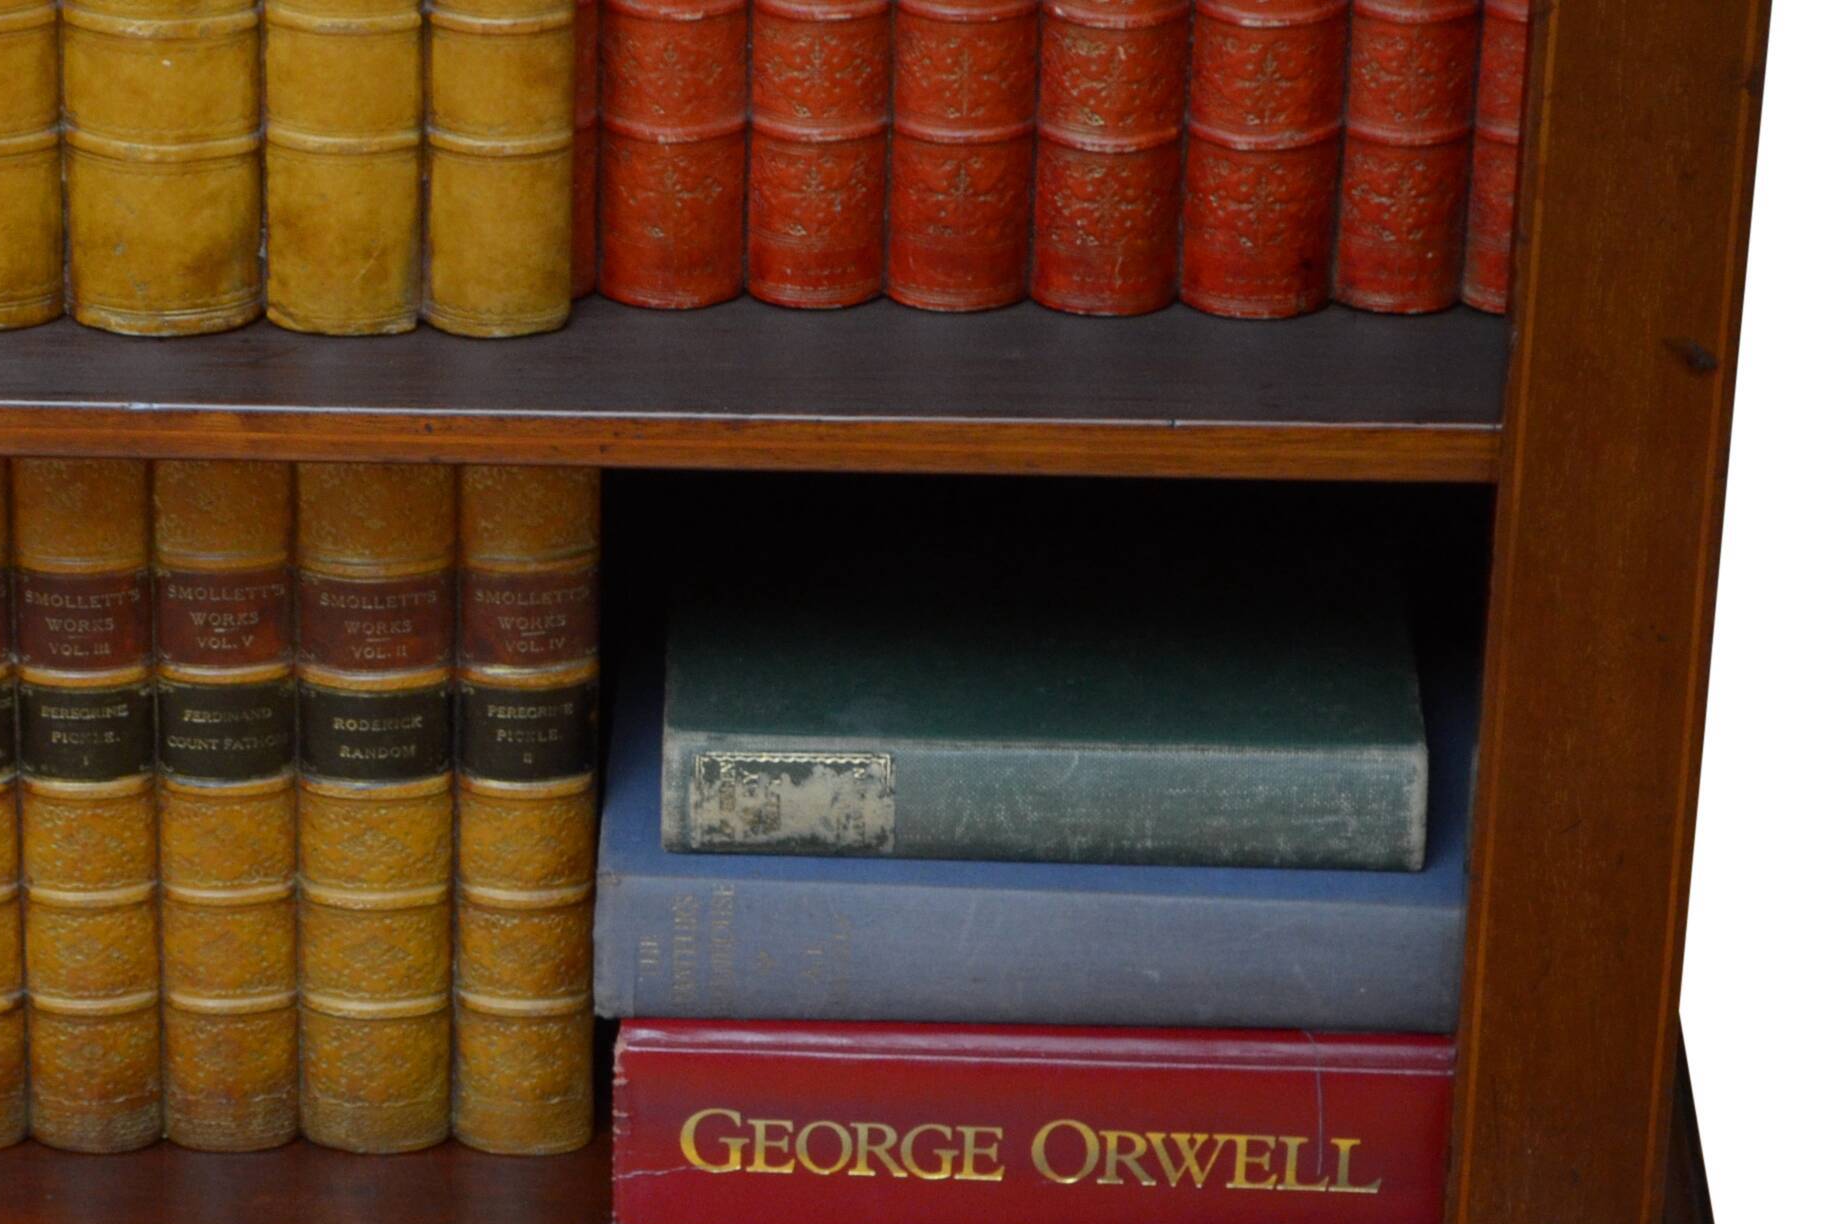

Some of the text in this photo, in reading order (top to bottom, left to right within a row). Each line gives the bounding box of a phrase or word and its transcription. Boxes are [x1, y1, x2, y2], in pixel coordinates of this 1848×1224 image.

[44, 616, 115, 633] WORKS
[189, 610, 261, 627] WORKS
[343, 618, 413, 636] WORKS
[241, 634, 256, 648] V
[332, 715, 424, 732] RODERICK
[166, 735, 219, 752] COUNT
[338, 743, 417, 760] RANDOM
[679, 1107, 1383, 1195] GEORGE ORWELL
